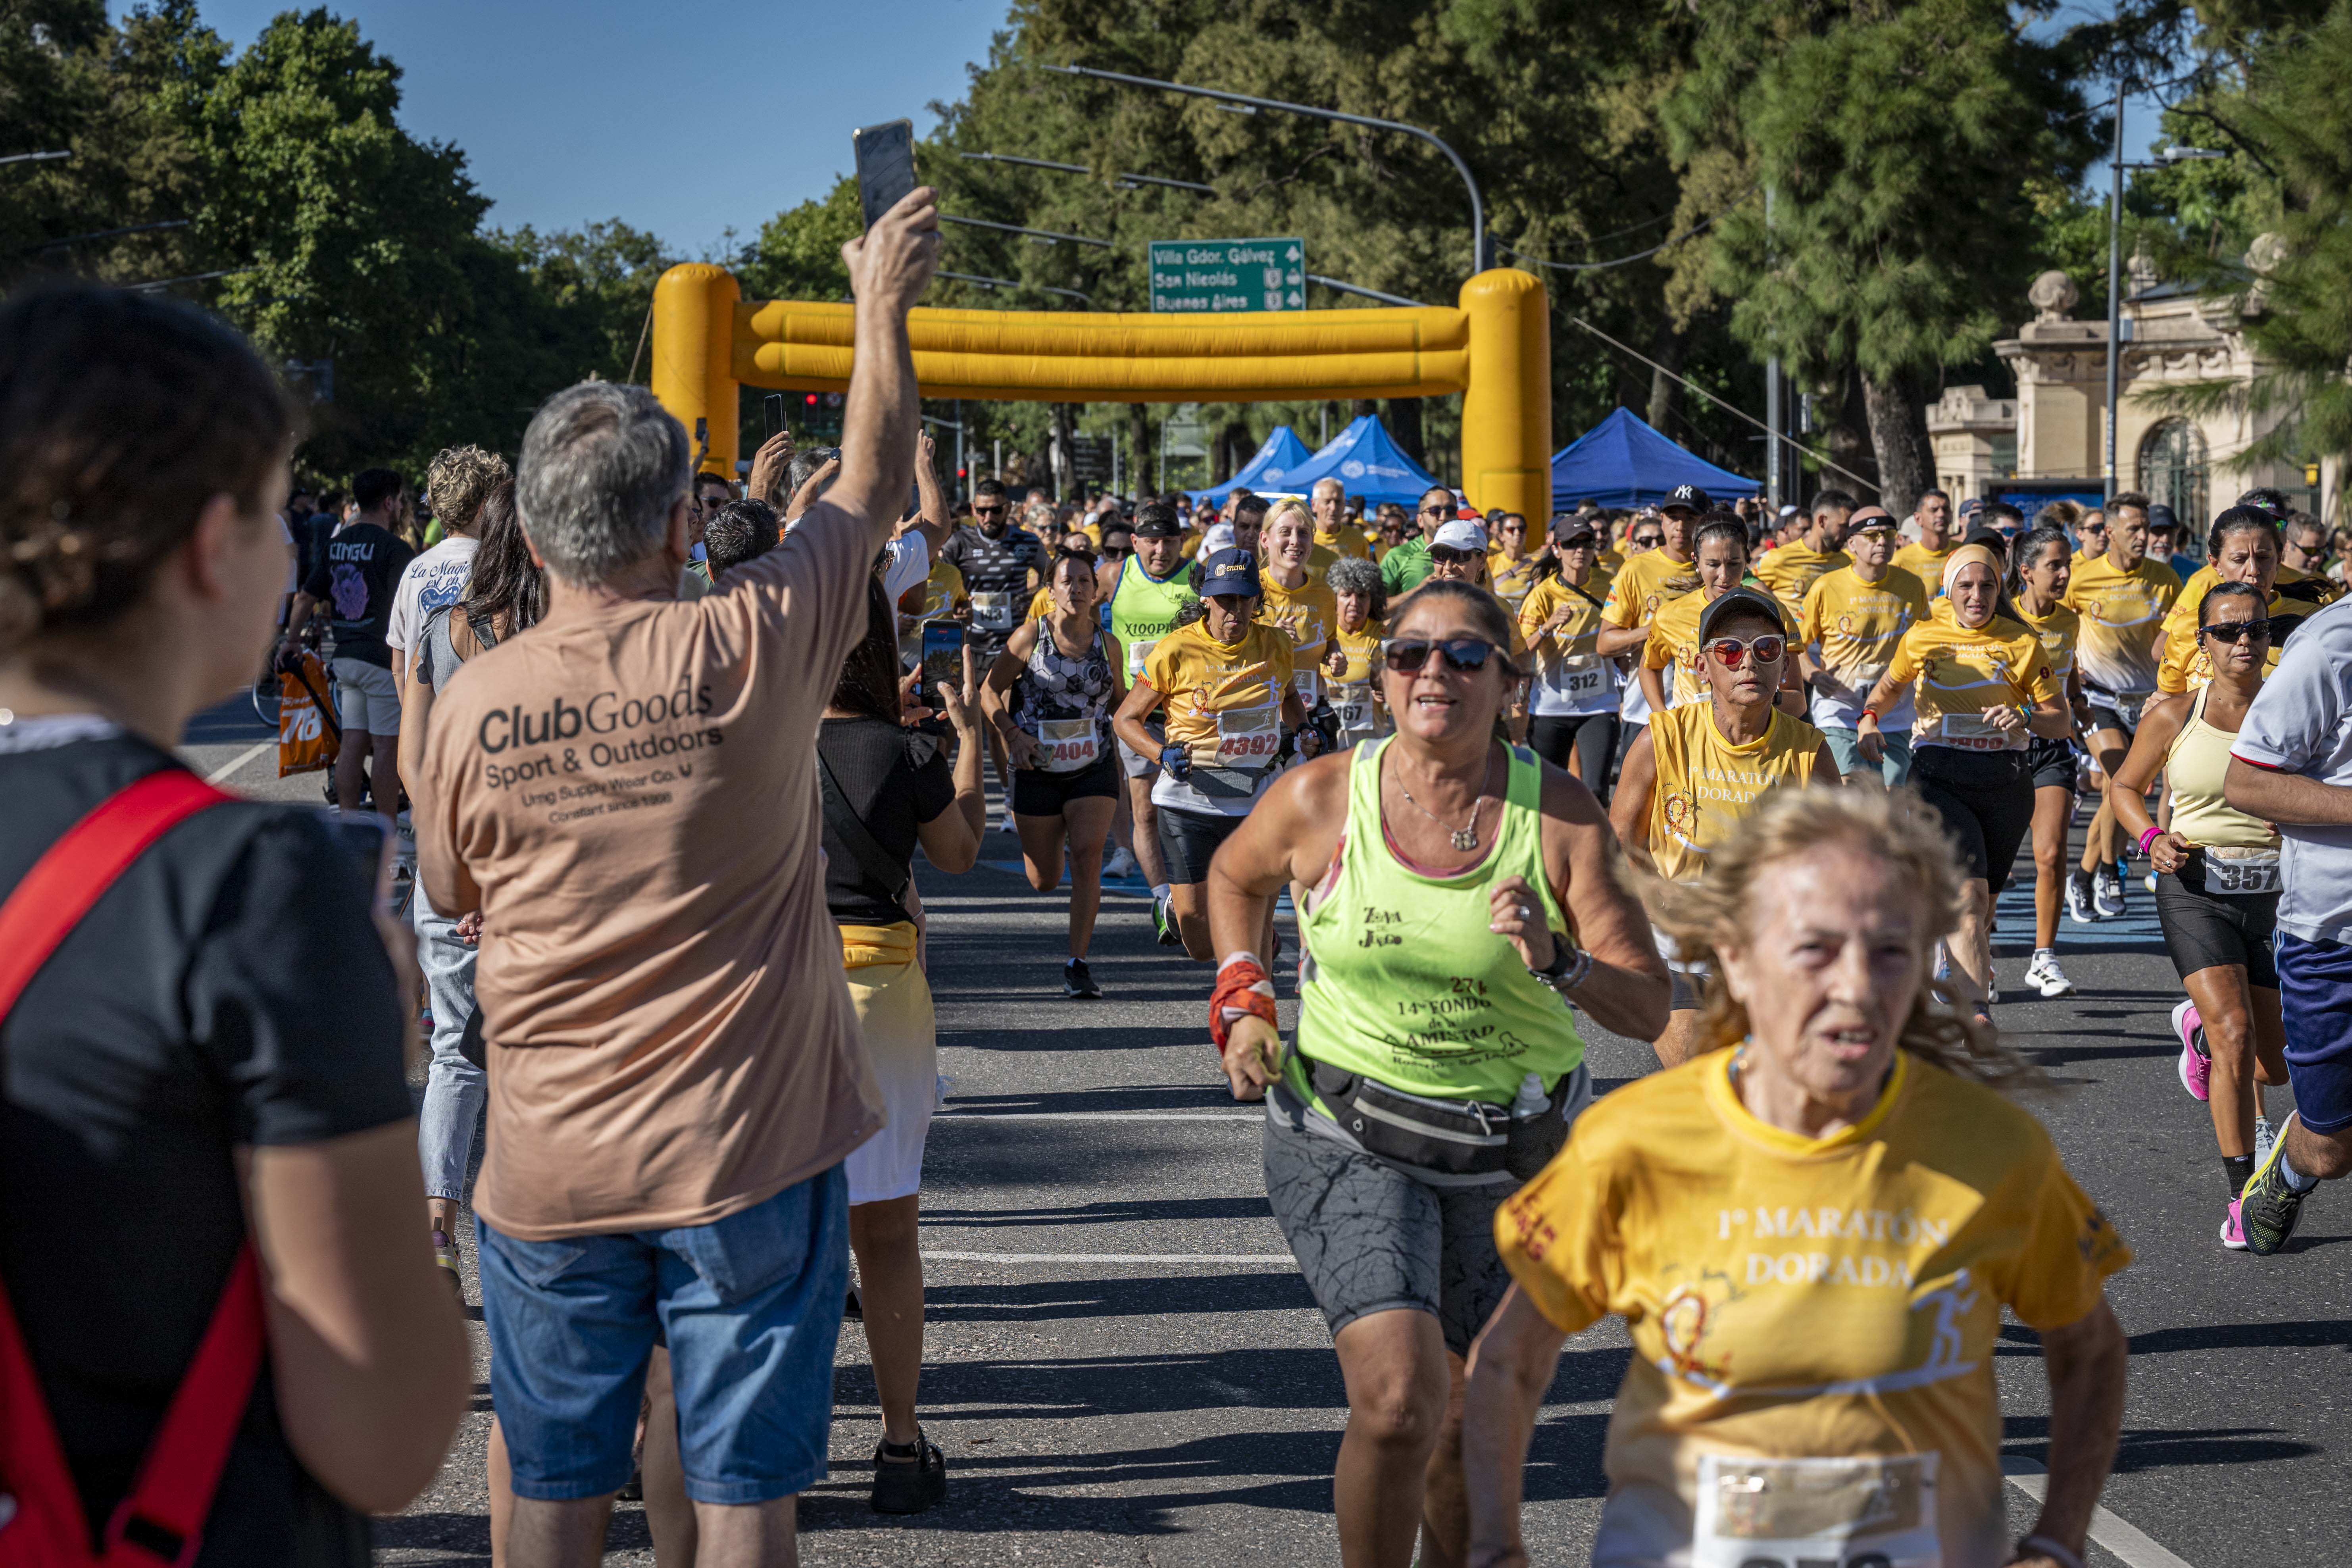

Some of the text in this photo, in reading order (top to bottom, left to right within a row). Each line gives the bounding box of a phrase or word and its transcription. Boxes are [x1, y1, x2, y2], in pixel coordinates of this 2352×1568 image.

[1154, 250, 1183, 264] Villa
[1155, 269, 1238, 289] San Nicolás
[1156, 294, 1248, 310] Buenos Aires
[409, 562, 427, 579] La
[426, 576, 442, 588] est
[446, 577, 459, 586] en
[1216, 674, 1261, 685] DORADA
[1569, 673, 1598, 691] 312
[281, 706, 323, 744] 78
[1219, 733, 1278, 756] 4392
[486, 726, 724, 790] Sport & Outdoors
[1702, 768, 1781, 786] MARATÓN
[1698, 786, 1756, 804] DORAD
[2220, 865, 2280, 891] 357
[1429, 996, 1492, 1013] FONDO
[1407, 1025, 1495, 1047] AMISTAD
[1755, 1206, 1950, 1248] MARATÓN
[1745, 1252, 1914, 1289] DORADA
